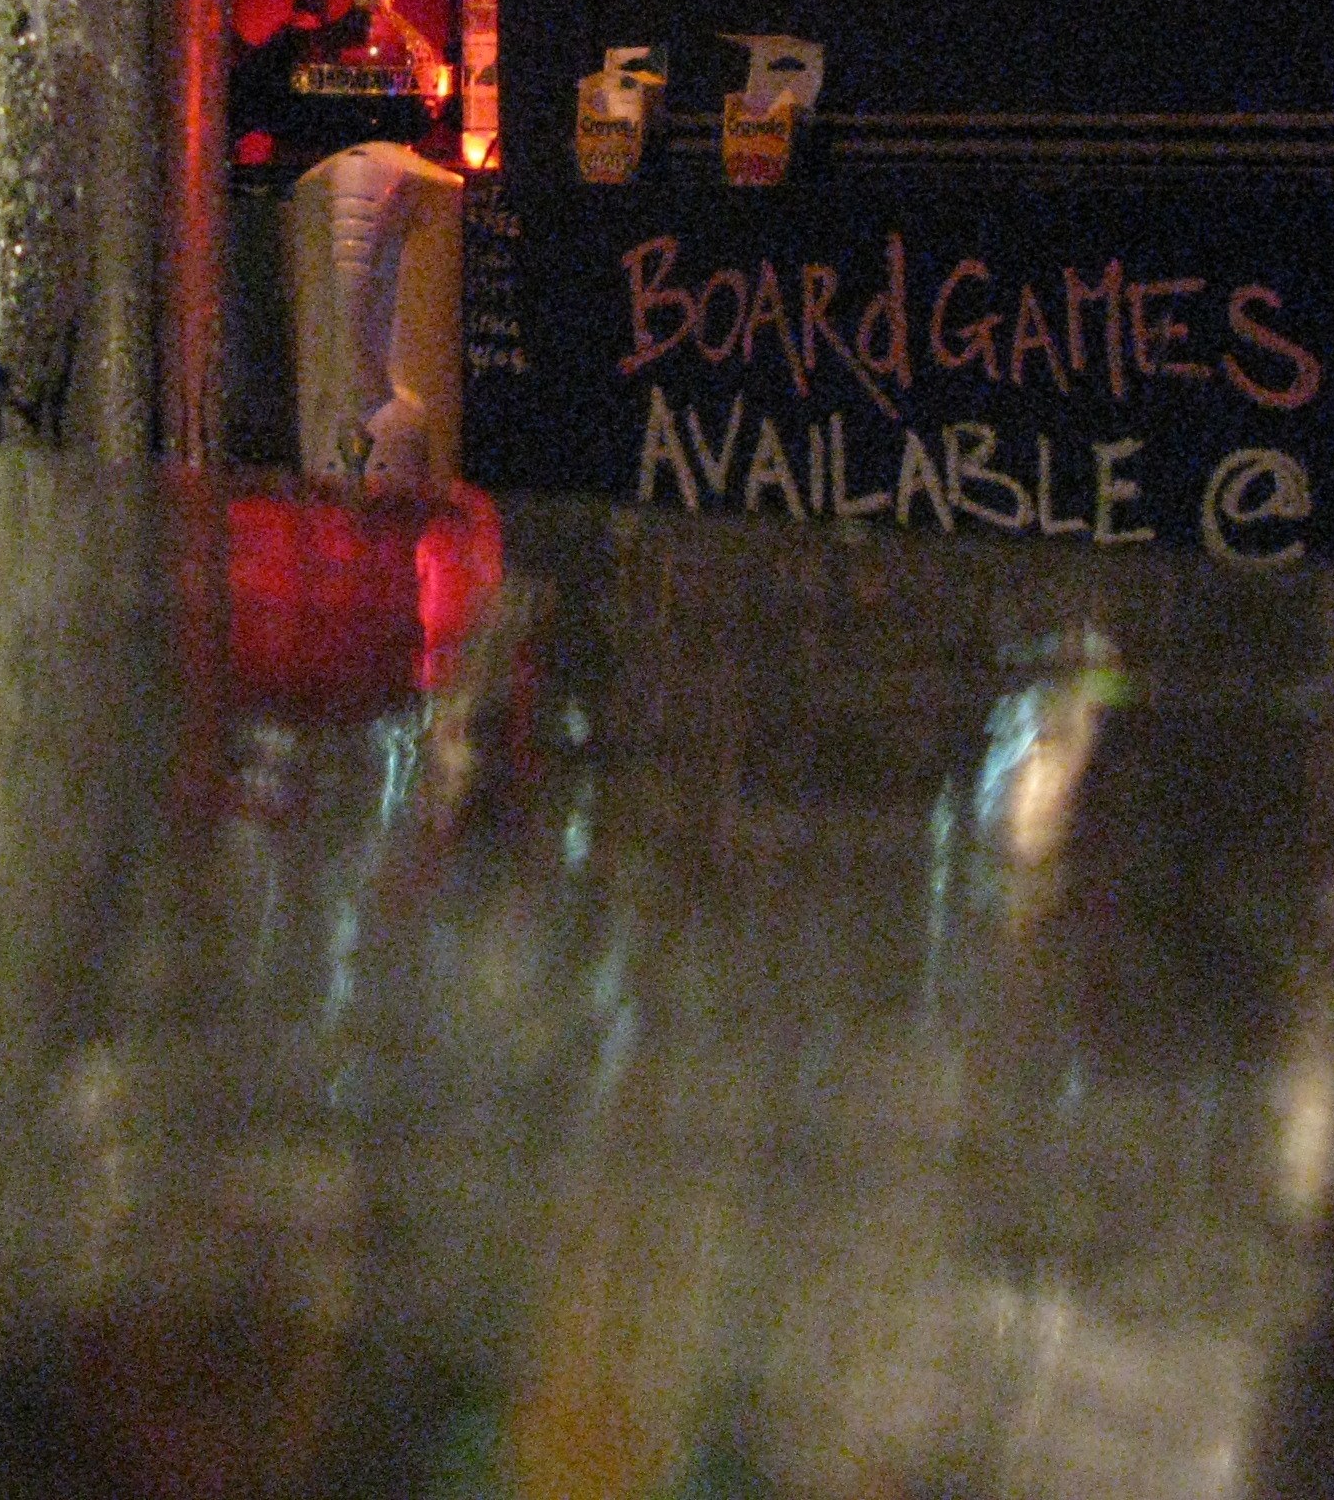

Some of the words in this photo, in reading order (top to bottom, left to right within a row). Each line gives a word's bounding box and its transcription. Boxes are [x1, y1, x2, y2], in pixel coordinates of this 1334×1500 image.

[929, 256, 1325, 410] GAMES
[638, 385, 1158, 546] AVAILABLE
[1200, 445, 1314, 567] @
